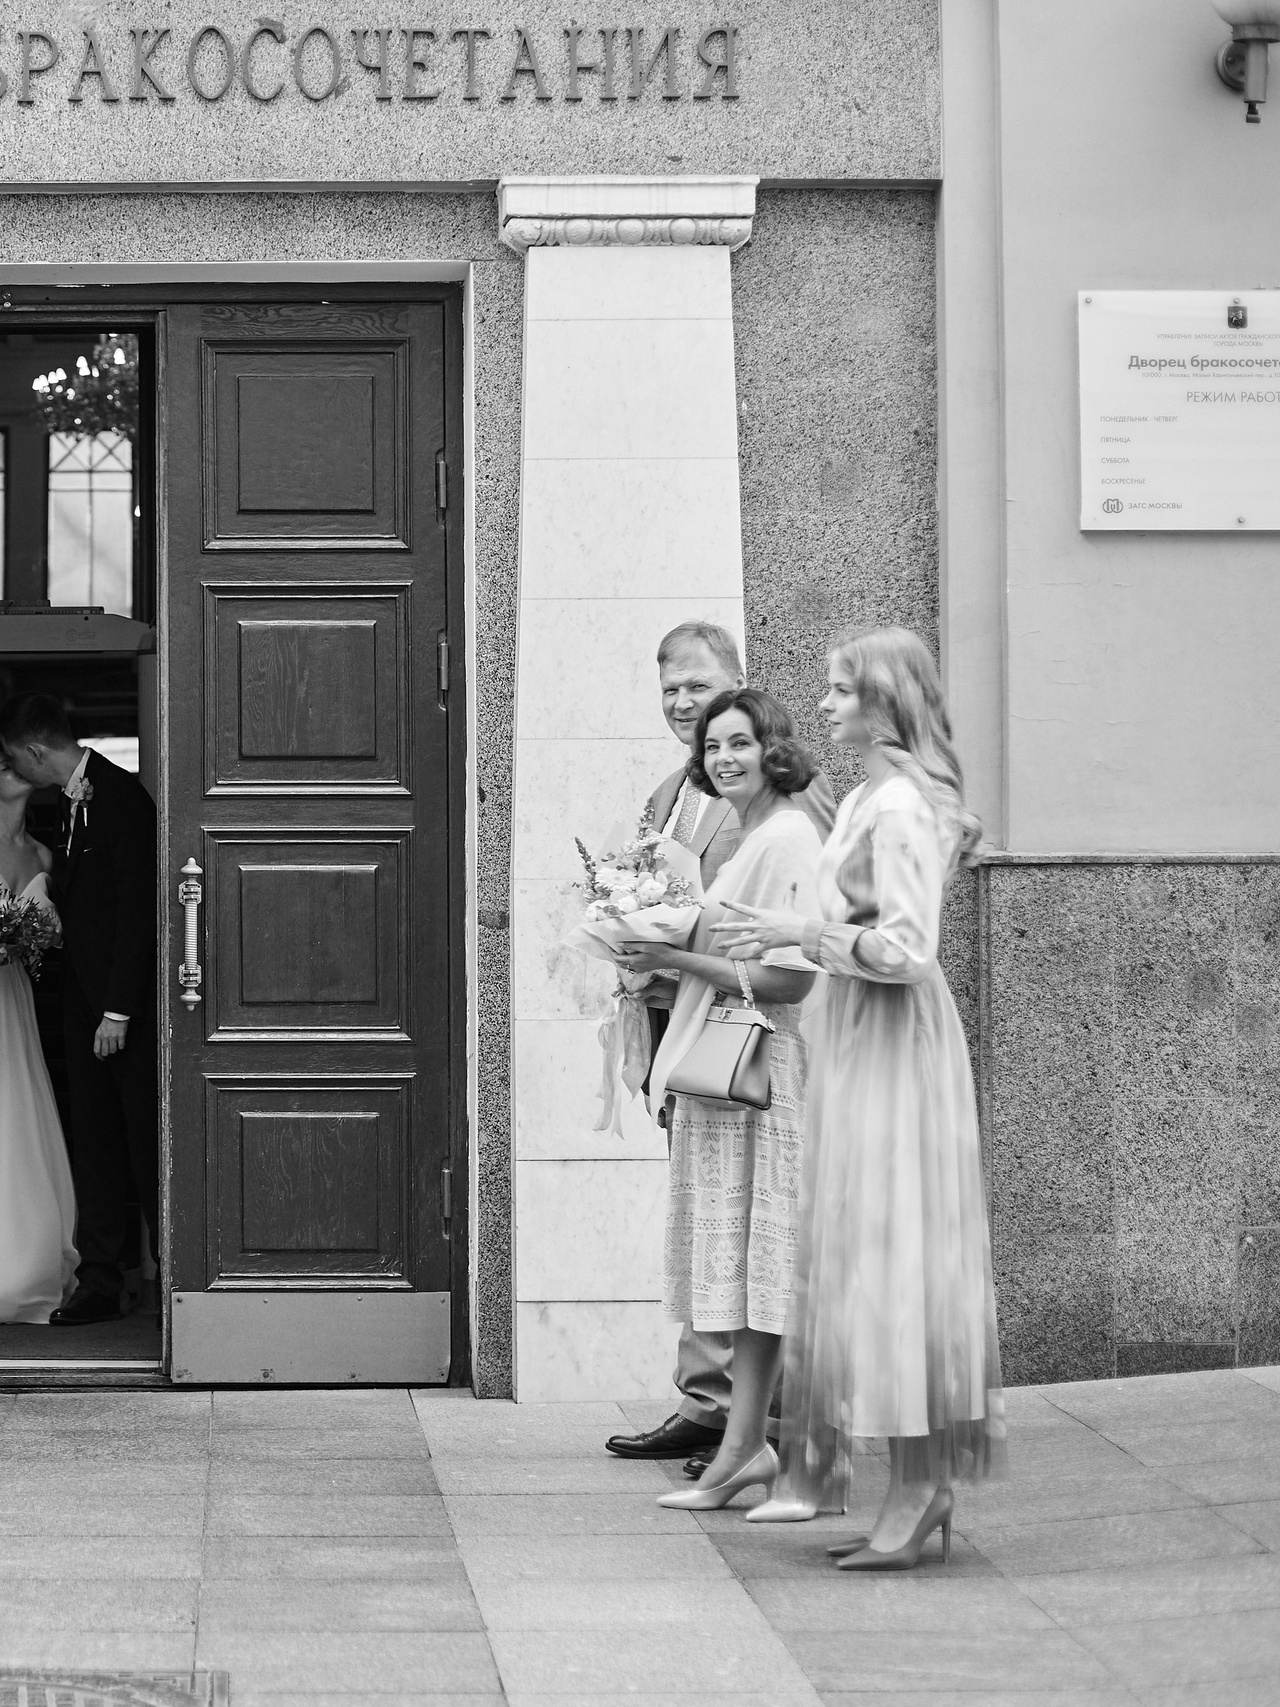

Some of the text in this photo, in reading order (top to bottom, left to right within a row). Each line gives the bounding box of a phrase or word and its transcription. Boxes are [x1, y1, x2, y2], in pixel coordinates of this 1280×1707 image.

[1128, 354, 1280, 371] Дворец бракосочет
[1186, 391, 1237, 403] РЕЖИМ
